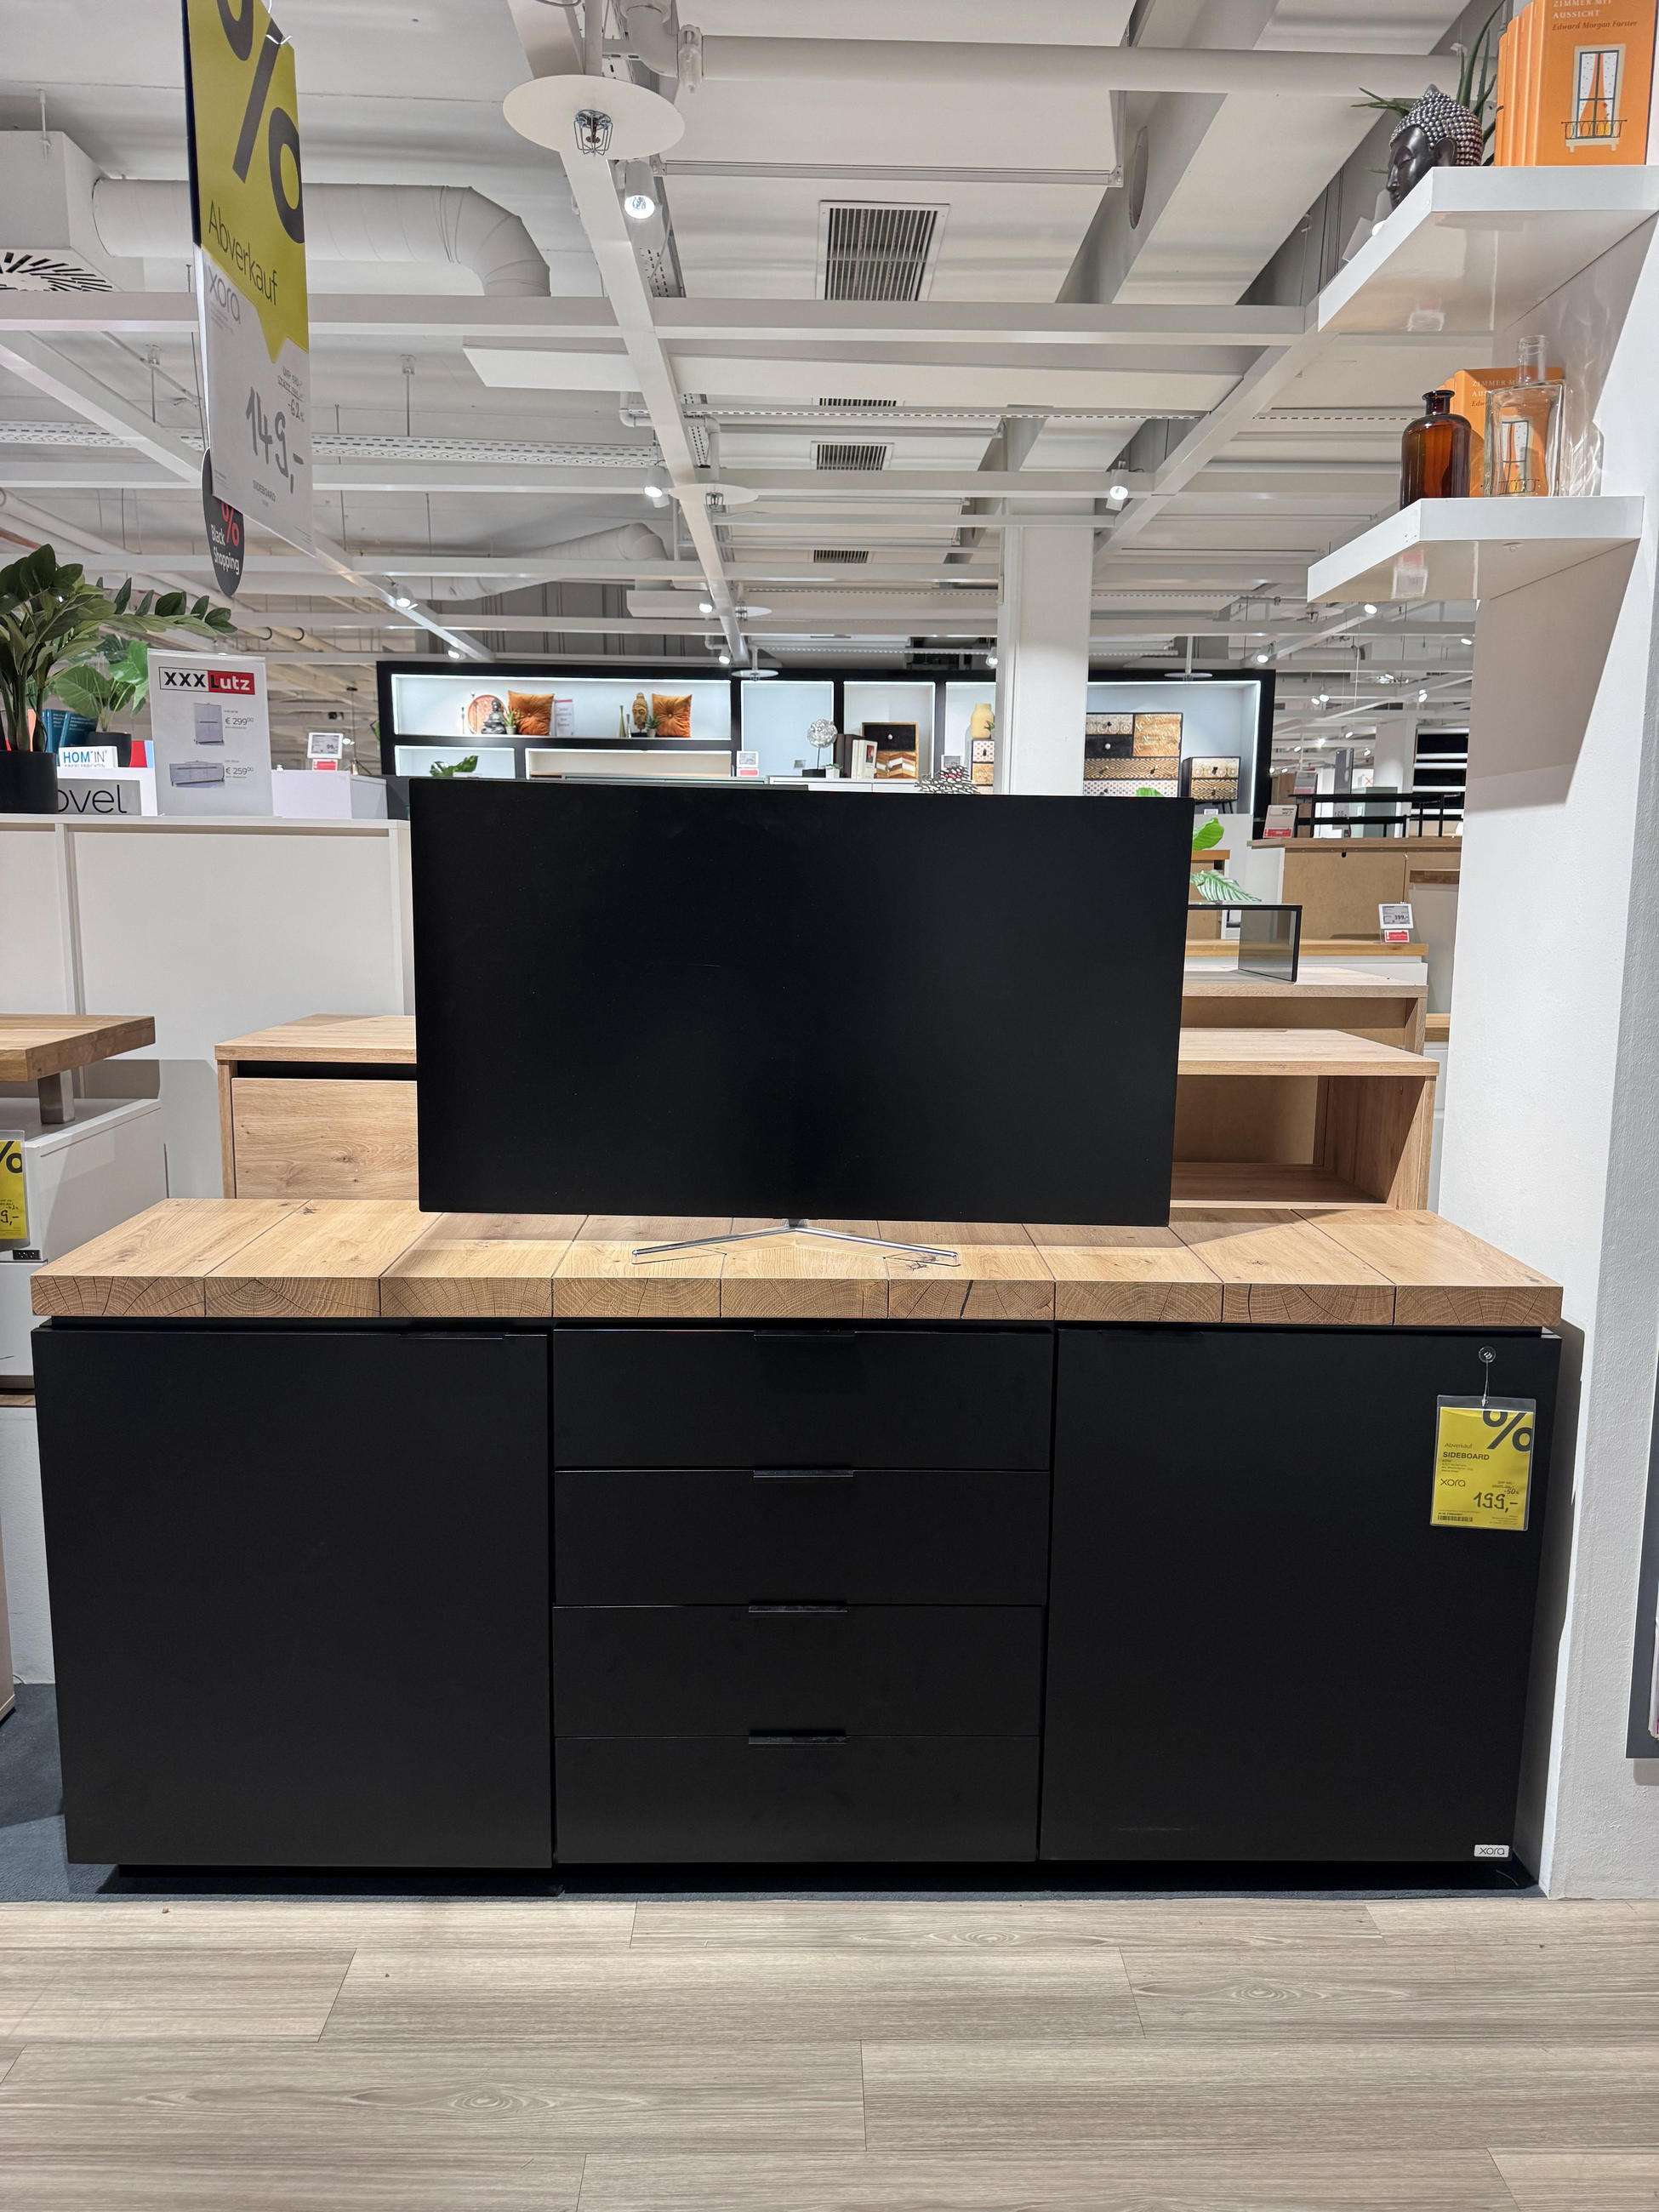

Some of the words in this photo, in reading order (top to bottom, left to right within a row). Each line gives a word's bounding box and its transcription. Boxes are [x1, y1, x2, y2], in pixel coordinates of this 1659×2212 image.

[1553, 9, 1600, 19] AUSSICHT
[1552, 22, 1581, 31] Edward
[1582, 21, 1610, 30] Morgan
[208, 198, 278, 307] Abverkauf
[208, 265, 242, 325] xora
[210, 524, 226, 546] Black
[213, 546, 240, 575] Shopping
[1482, 1411, 1532, 1452] %
[1442, 1451, 1490, 1462] SIDEBOARD
[1440, 1478, 1467, 1488] xora
[1479, 1847, 1505, 1856] xora
